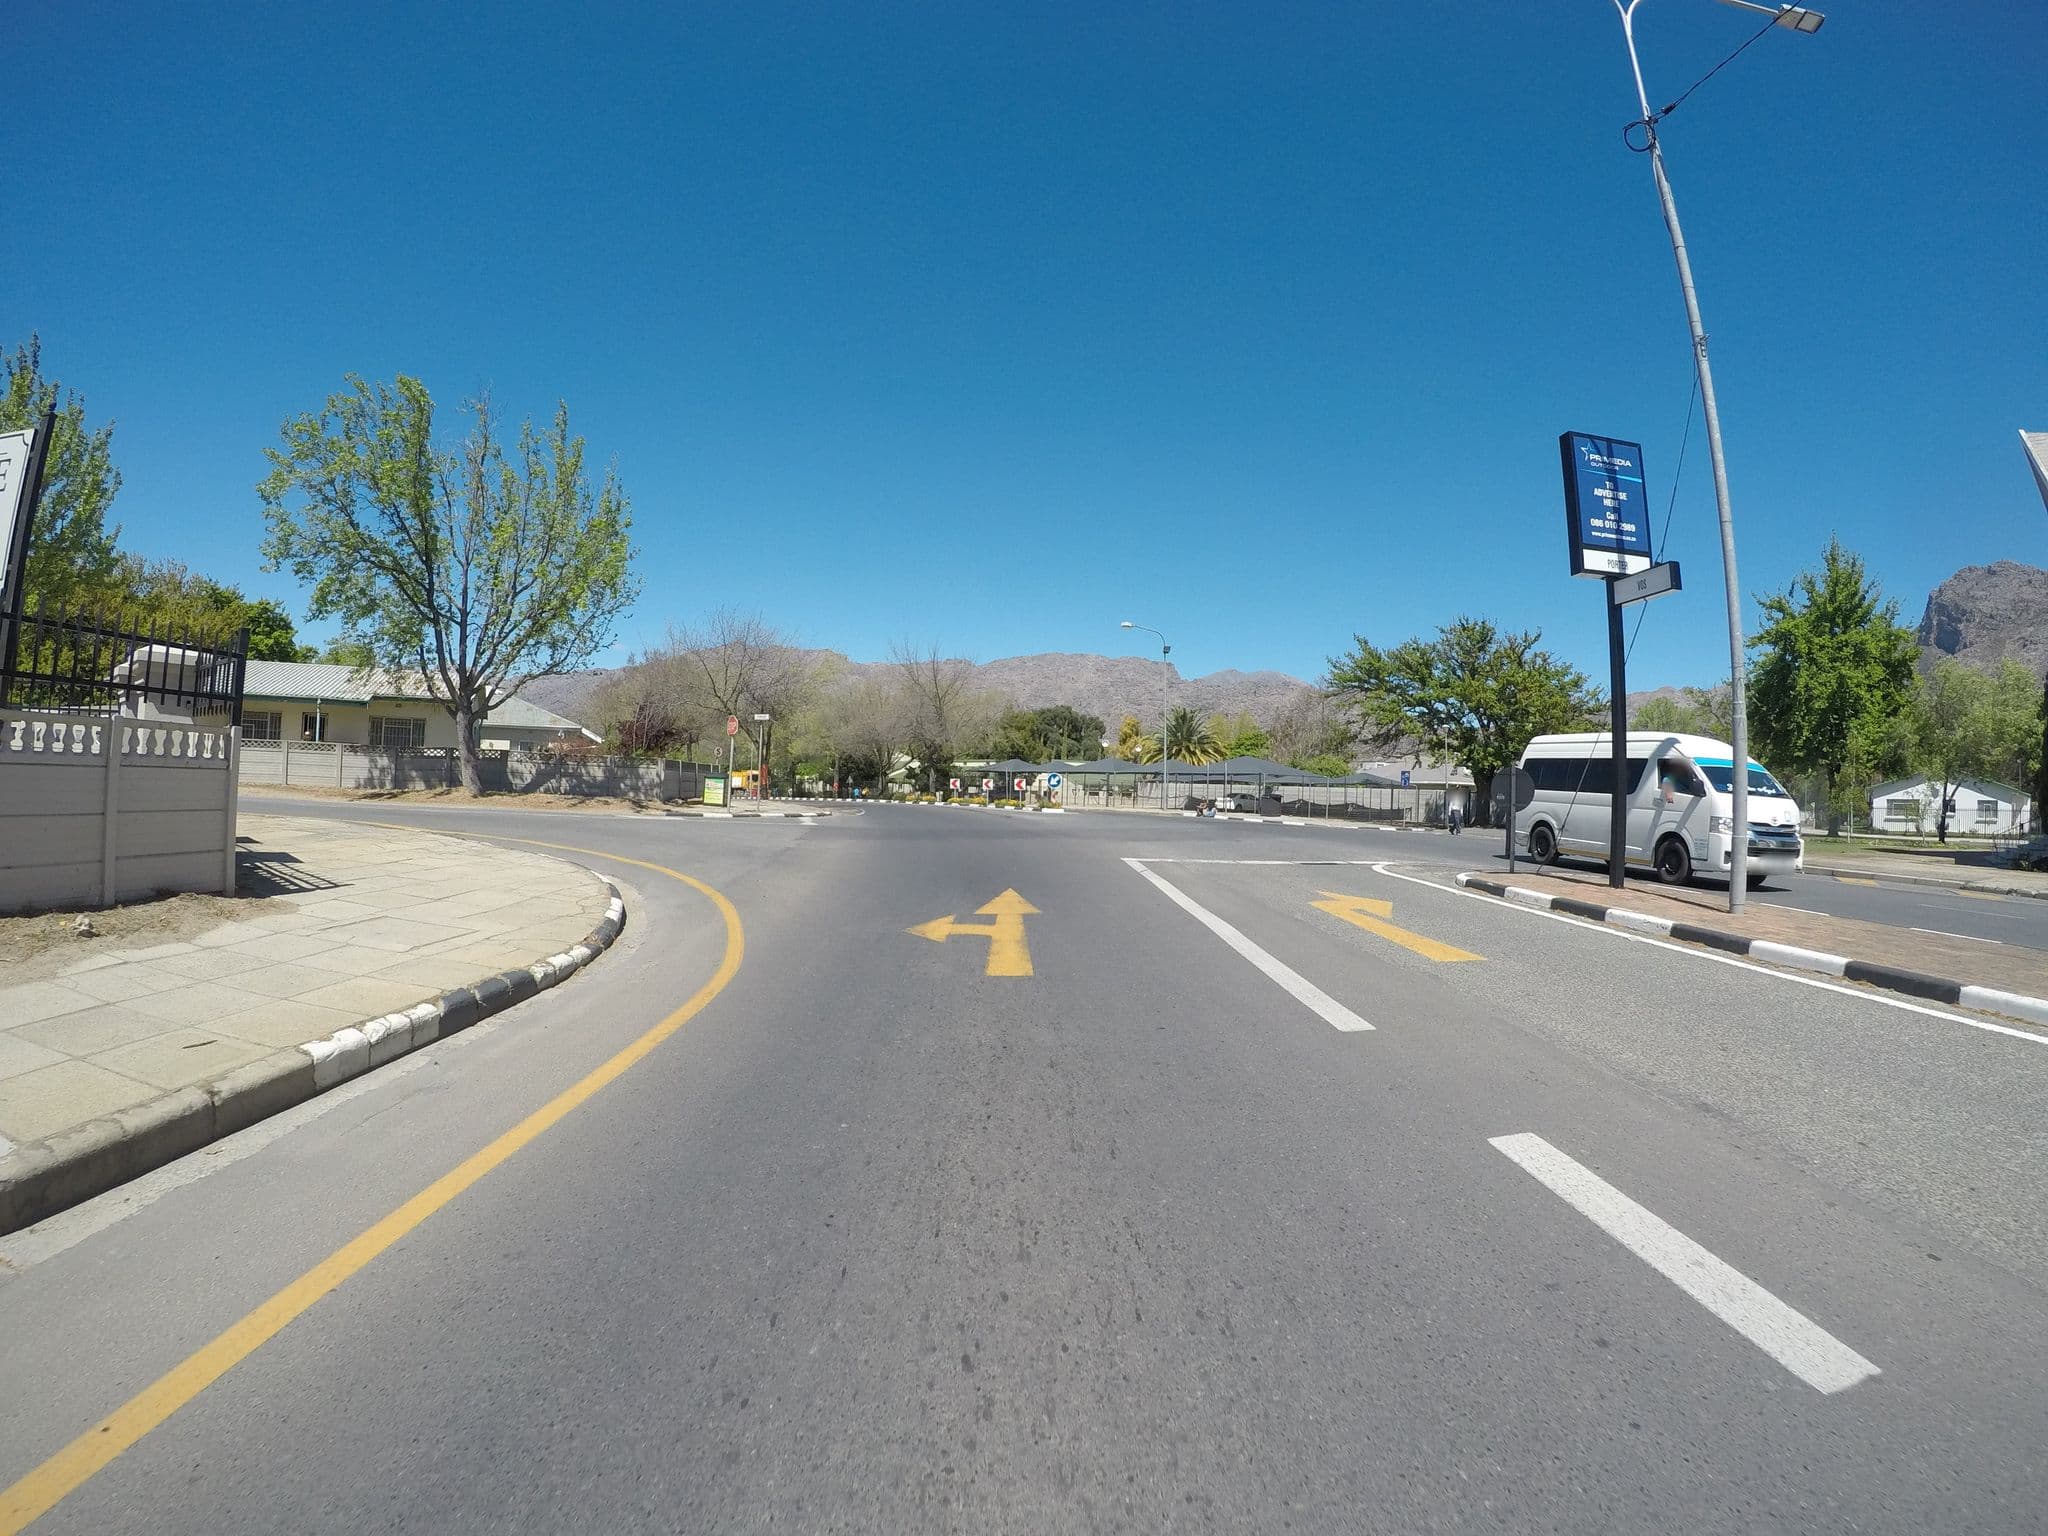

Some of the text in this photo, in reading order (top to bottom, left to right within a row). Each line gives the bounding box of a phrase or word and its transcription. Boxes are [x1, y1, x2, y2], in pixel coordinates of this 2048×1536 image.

[1589, 453, 1632, 467] PRIMEDIA
[1605, 481, 1615, 489] TO
[1593, 487, 1628, 501] ADVERTISE
[1603, 498, 1620, 507] HERE
[1607, 558, 1629, 570] PORTER
